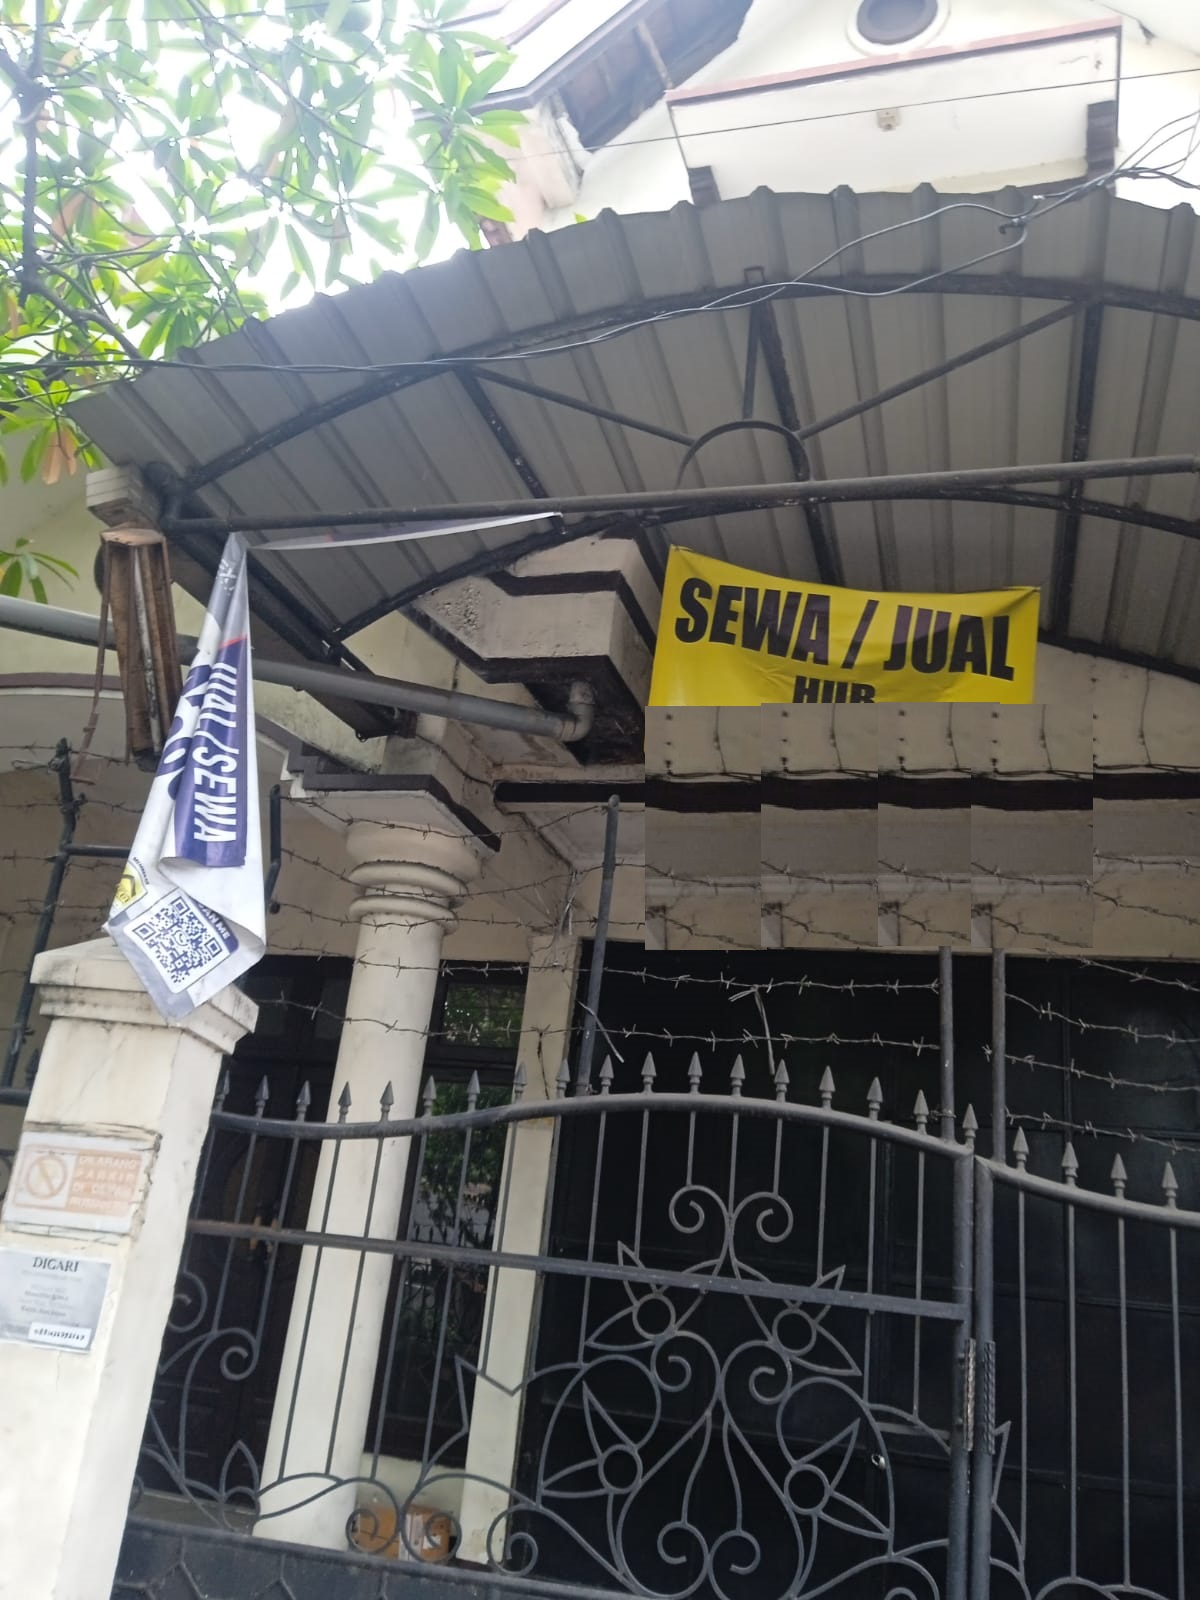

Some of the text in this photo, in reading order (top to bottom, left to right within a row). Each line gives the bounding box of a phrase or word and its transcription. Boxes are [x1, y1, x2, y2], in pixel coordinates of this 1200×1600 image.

[674, 577, 1014, 681] SEWA / JUAL
